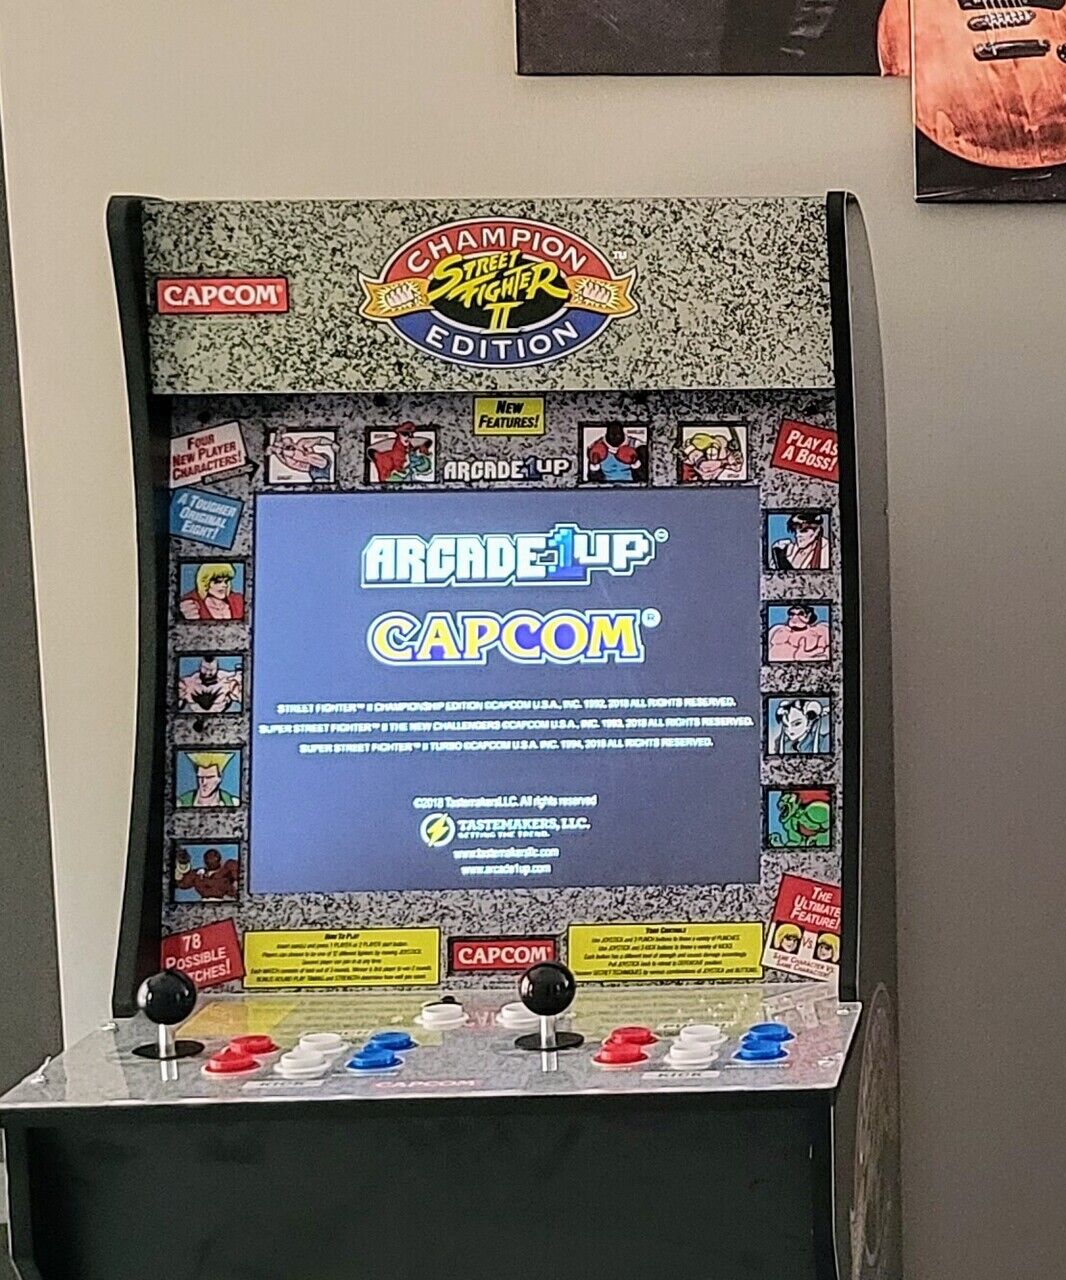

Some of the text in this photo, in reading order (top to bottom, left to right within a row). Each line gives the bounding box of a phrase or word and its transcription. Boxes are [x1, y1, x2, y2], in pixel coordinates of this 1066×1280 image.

[407, 227, 587, 273] CHAMPION
[427, 250, 521, 302] STREET
[449, 261, 570, 308] FIGHTER
[484, 301, 525, 333] II
[425, 321, 579, 360] EDITION
[495, 399, 524, 415] NEW
[477, 413, 540, 430] FEATURES!
[187, 433, 215, 451] FOUR
[786, 430, 838, 456] PLAY AS
[172, 441, 237, 468] NEW PLAYER
[172, 451, 242, 481] CHARACTERS!
[780, 445, 838, 472] A BOSS!
[177, 493, 238, 518] A TOUGHER
[178, 506, 228, 529] ORIGINAL
[181, 520, 219, 540] EIGHT!
[794, 895, 841, 918] ULTIMATE
[811, 886, 833, 903] THE
[790, 907, 841, 930] FEATURE!
[181, 933, 202, 952] 78
[165, 946, 227, 970] POSSIBLE
